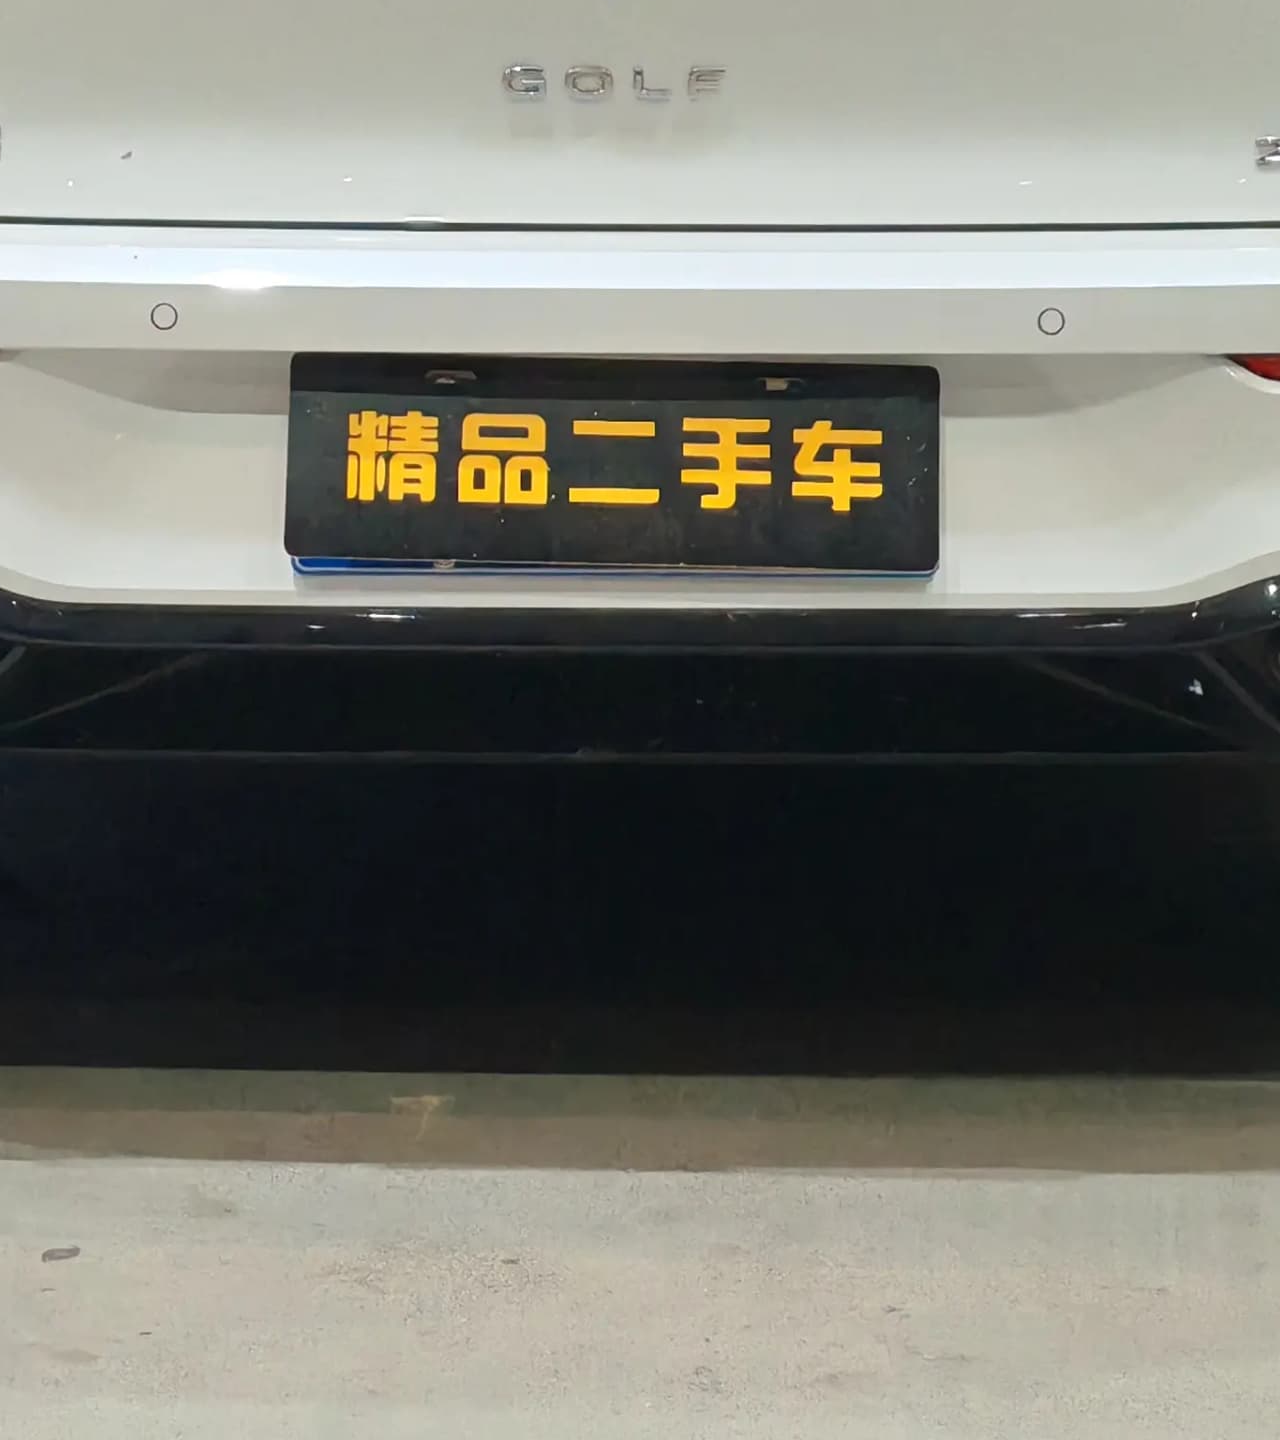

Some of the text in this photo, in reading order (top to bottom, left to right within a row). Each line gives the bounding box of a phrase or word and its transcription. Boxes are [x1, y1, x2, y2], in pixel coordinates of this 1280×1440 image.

[502, 64, 727, 101] GOLF
[347, 410, 883, 512] 精品二手车
